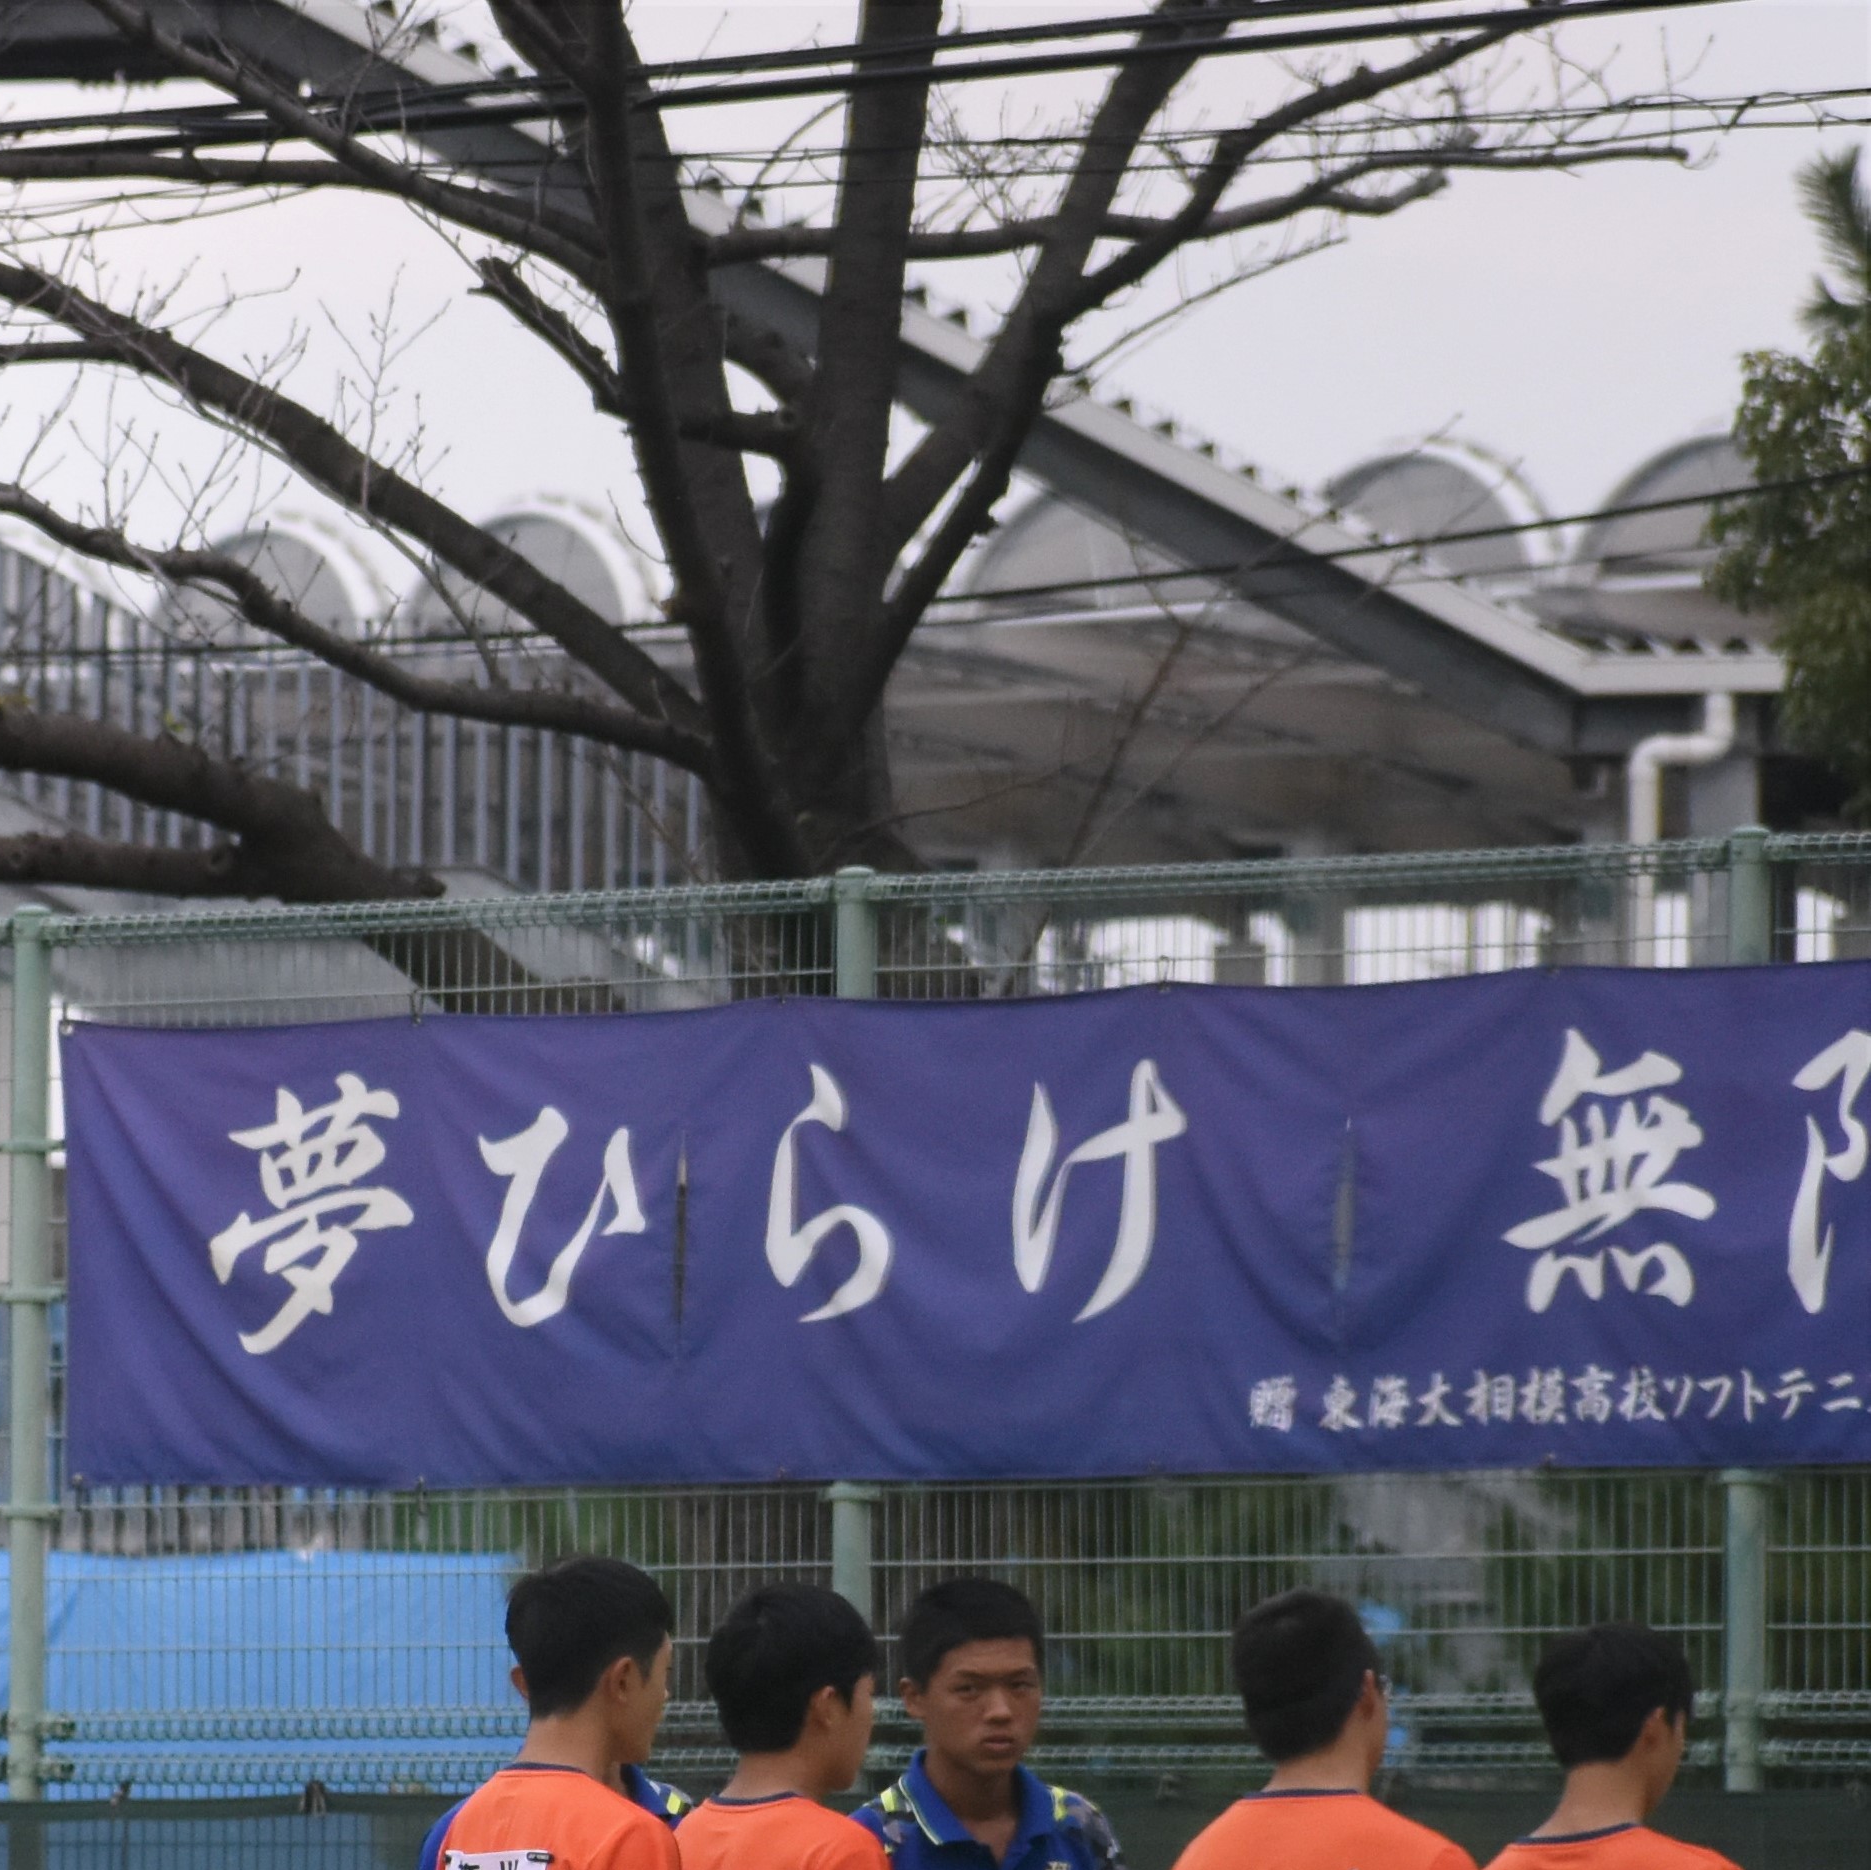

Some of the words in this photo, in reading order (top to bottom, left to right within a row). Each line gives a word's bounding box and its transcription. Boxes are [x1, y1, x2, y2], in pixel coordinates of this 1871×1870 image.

[209, 1058, 1188, 1356] 夢ひらけ
[1322, 1364, 1871, 1432] 東海大相模高校ソフトテニ
